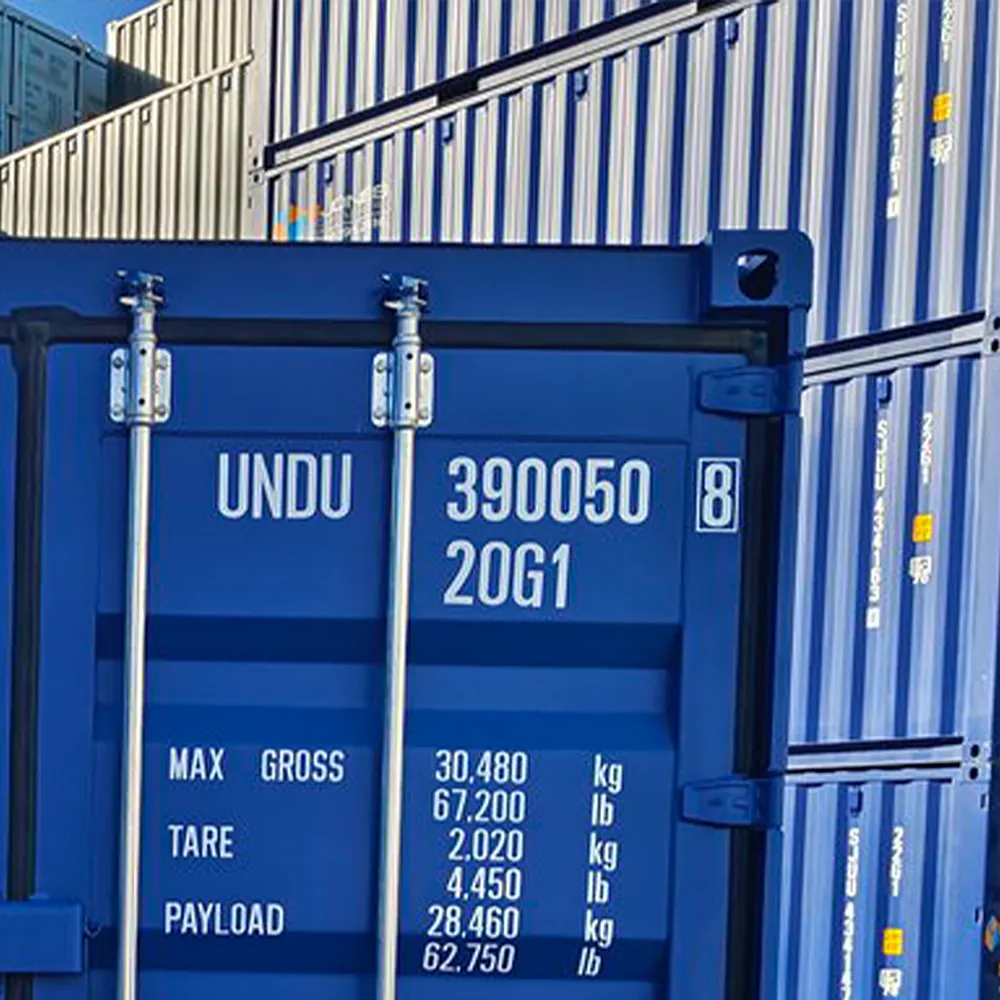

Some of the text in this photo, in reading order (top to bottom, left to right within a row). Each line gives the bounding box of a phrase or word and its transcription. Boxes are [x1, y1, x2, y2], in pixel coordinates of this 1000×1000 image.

[217, 453, 734, 528] UNDU 390050 8
[443, 540, 570, 609] 20G1
[169, 748, 623, 794] MAX GROSS 30.480 kg
[433, 789, 614, 827] 67.200 lb
[168, 825, 617, 872] TARE 2.020 kg
[446, 867, 609, 904] 4.450 lb
[165, 902, 614, 948] PAYLOAD 28.460 kg
[422, 943, 602, 976] 62.750 lb
